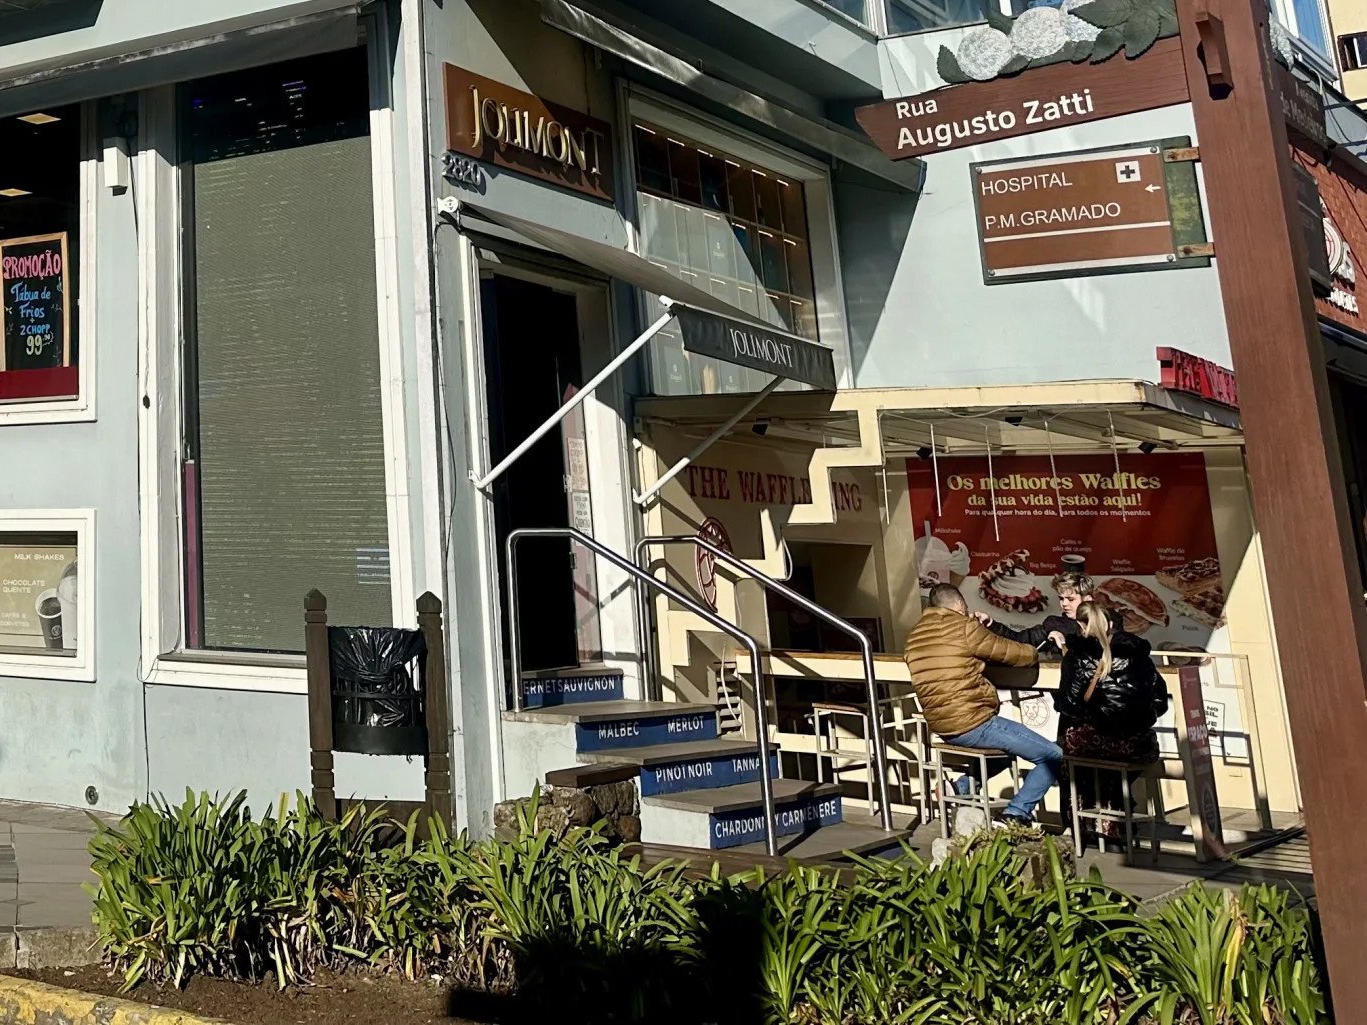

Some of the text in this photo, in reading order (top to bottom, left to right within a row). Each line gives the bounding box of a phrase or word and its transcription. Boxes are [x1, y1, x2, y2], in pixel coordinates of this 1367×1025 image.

[896, 99, 938, 119] Rua
[897, 89, 1094, 150] Augusto Zatti
[469, 85, 604, 175] JOLIMONT
[441, 152, 481, 186] 2820
[981, 172, 1073, 196] HOSPITAL
[984, 202, 1121, 230] P.M.GRAMADO
[2, 250, 61, 280] PROMOÇÃO
[11, 282, 51, 302] Tábua de
[19, 302, 45, 318] Frios
[730, 328, 792, 368] JOLIMONT
[685, 465, 862, 512] THE WAFFLE ING
[947, 472, 1161, 490] Os melhores Waffles
[968, 494, 986, 506] da
[1021, 494, 1053, 506] vida
[1059, 494, 1098, 506] estão
[1103, 493, 1142, 508] aqui!
[598, 716, 704, 739] MALBEC MERLOT
[656, 758, 760, 783] PINOT NOIR TANNA
[715, 813, 779, 838] CHARDONY
